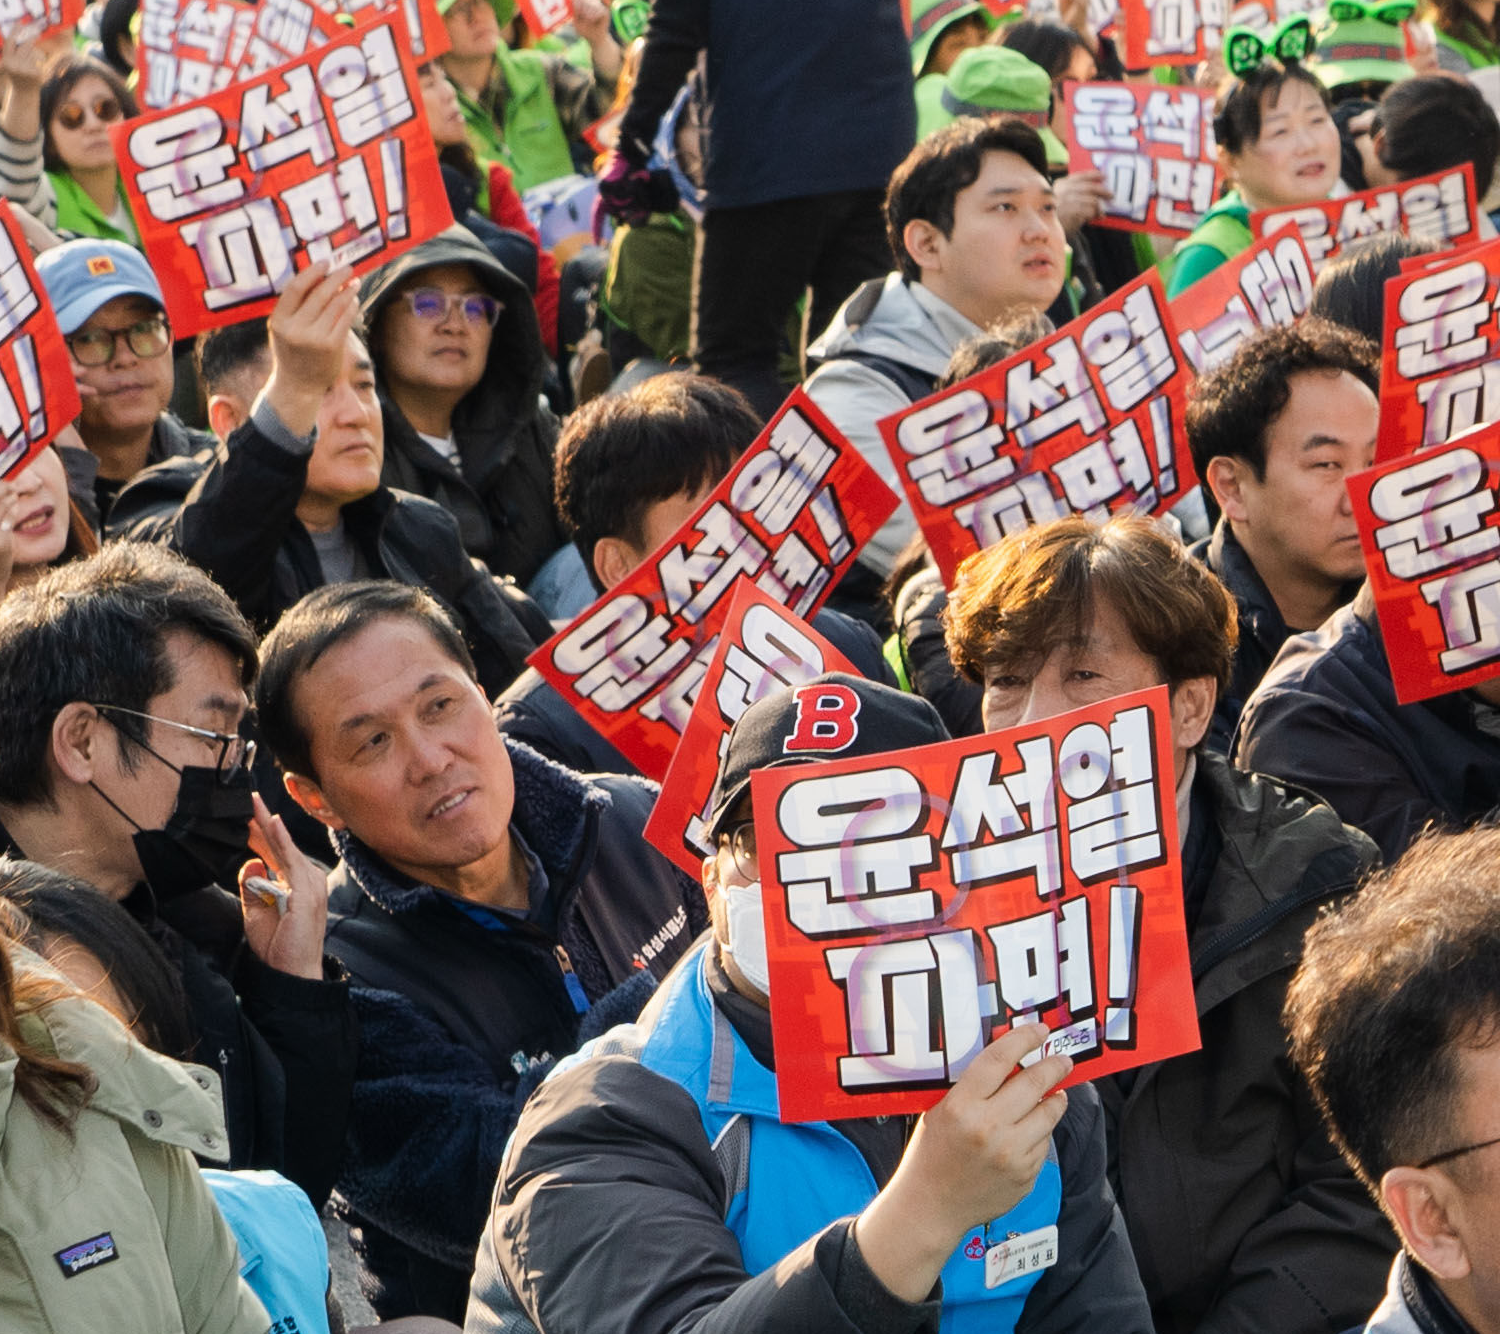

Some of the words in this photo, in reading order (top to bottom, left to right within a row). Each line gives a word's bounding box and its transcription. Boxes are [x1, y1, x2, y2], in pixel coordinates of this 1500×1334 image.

[127, 29, 418, 222] 윤석열
[1071, 84, 1218, 169] 윤석
[1100, 152, 1220, 230] 파면
[180, 138, 408, 311] 파면!
[895, 282, 1181, 510] 윤석열
[552, 404, 839, 714] 윤석열
[784, 683, 861, 753] B
[777, 705, 1163, 938] 윤석열
[824, 883, 1140, 1091] 파면!
